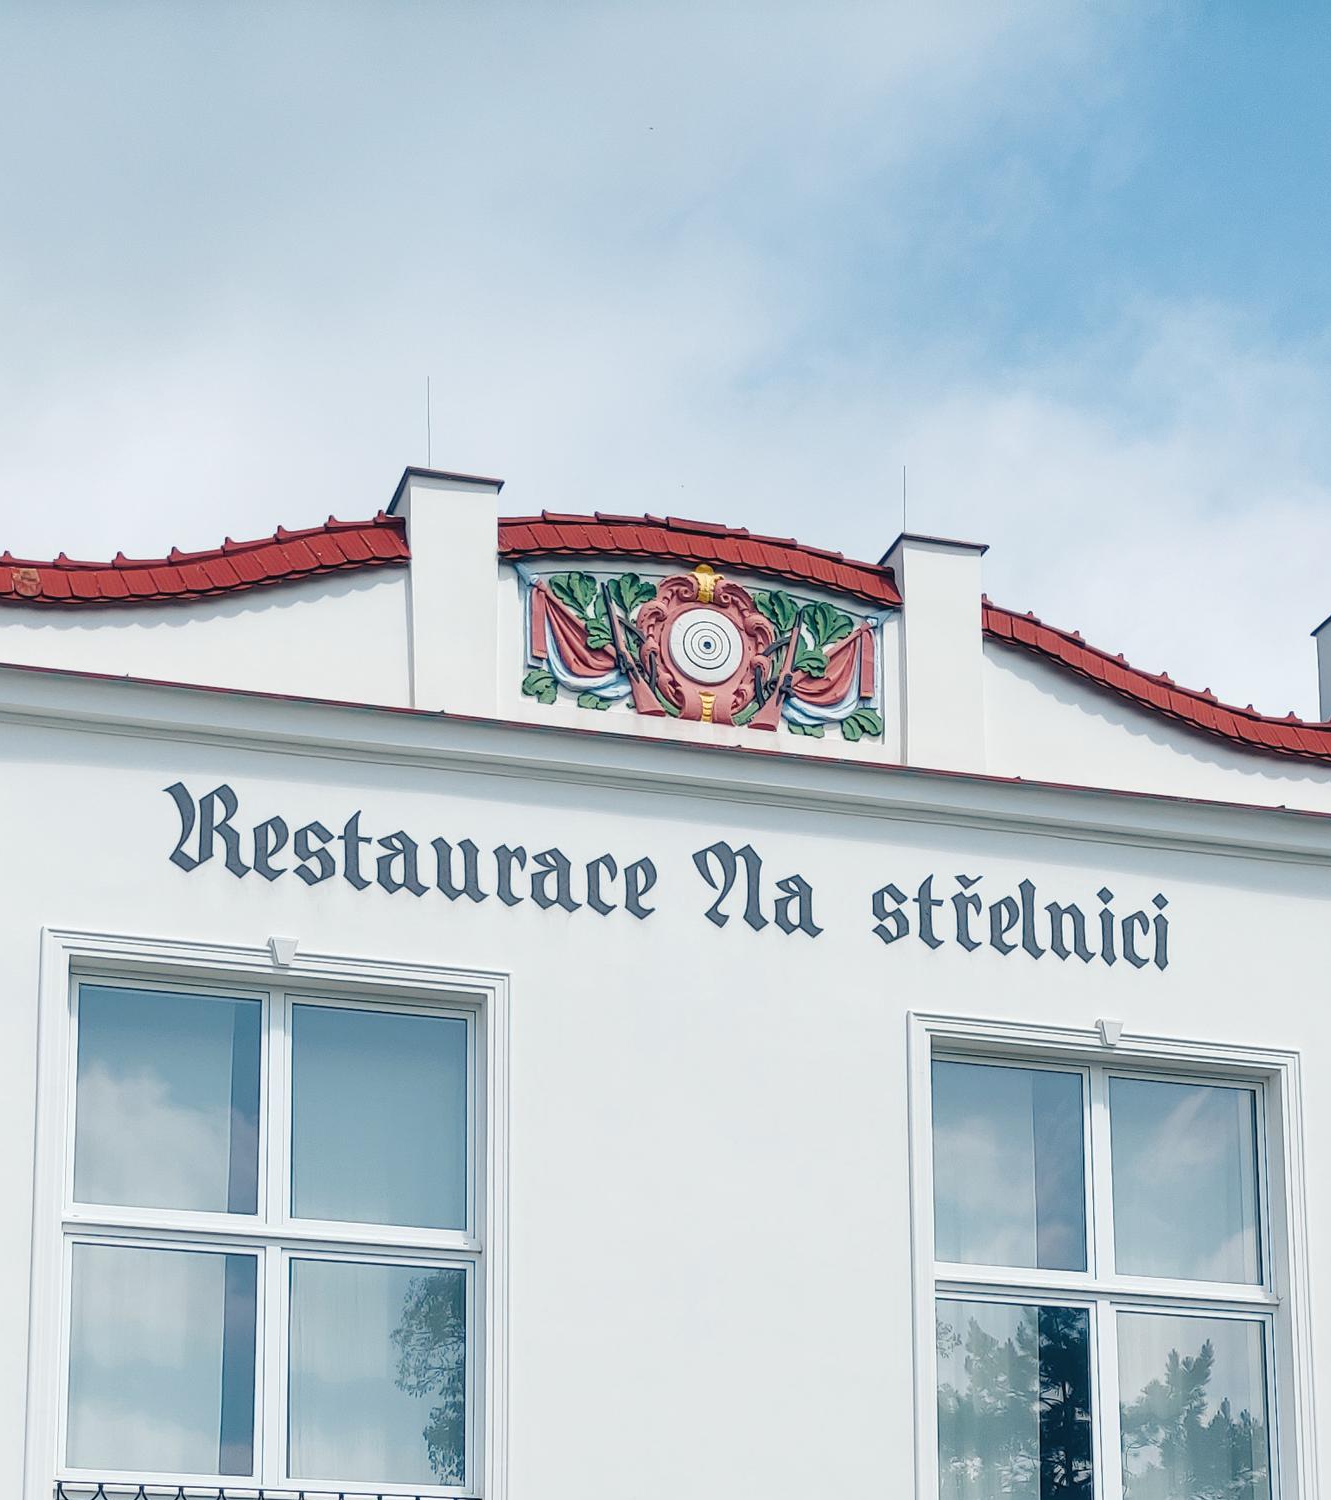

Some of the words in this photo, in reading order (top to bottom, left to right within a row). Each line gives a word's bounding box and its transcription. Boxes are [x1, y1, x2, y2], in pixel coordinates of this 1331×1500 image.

[163, 782, 657, 920] Restaurace
[692, 841, 823, 938] Na
[872, 873, 1168, 971] střelnici
